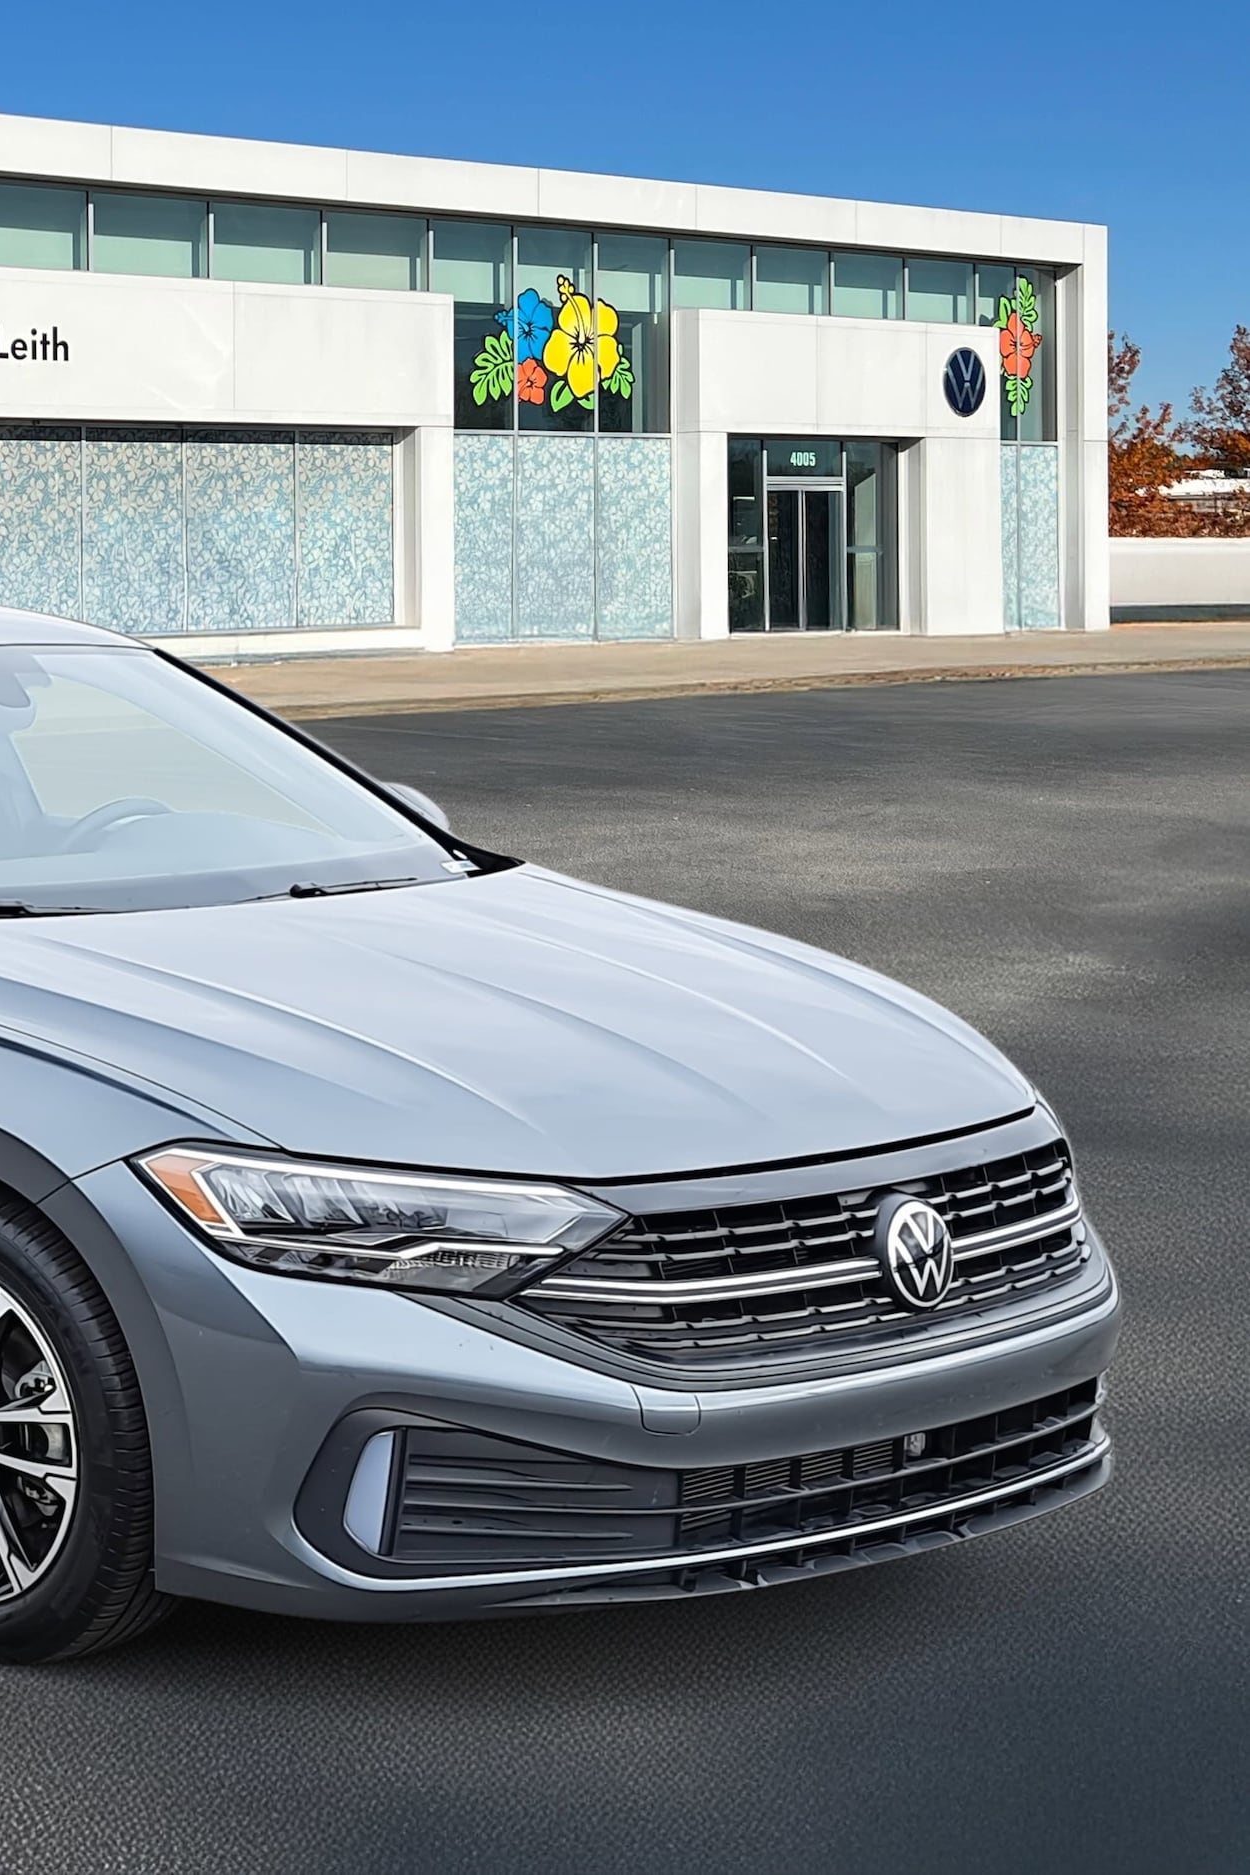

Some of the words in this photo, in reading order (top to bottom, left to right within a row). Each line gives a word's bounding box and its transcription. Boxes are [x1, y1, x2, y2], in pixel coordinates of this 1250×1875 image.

[946, 349, 984, 410] VW
[790, 451, 816, 466] 4005
[892, 1205, 948, 1301] VW
